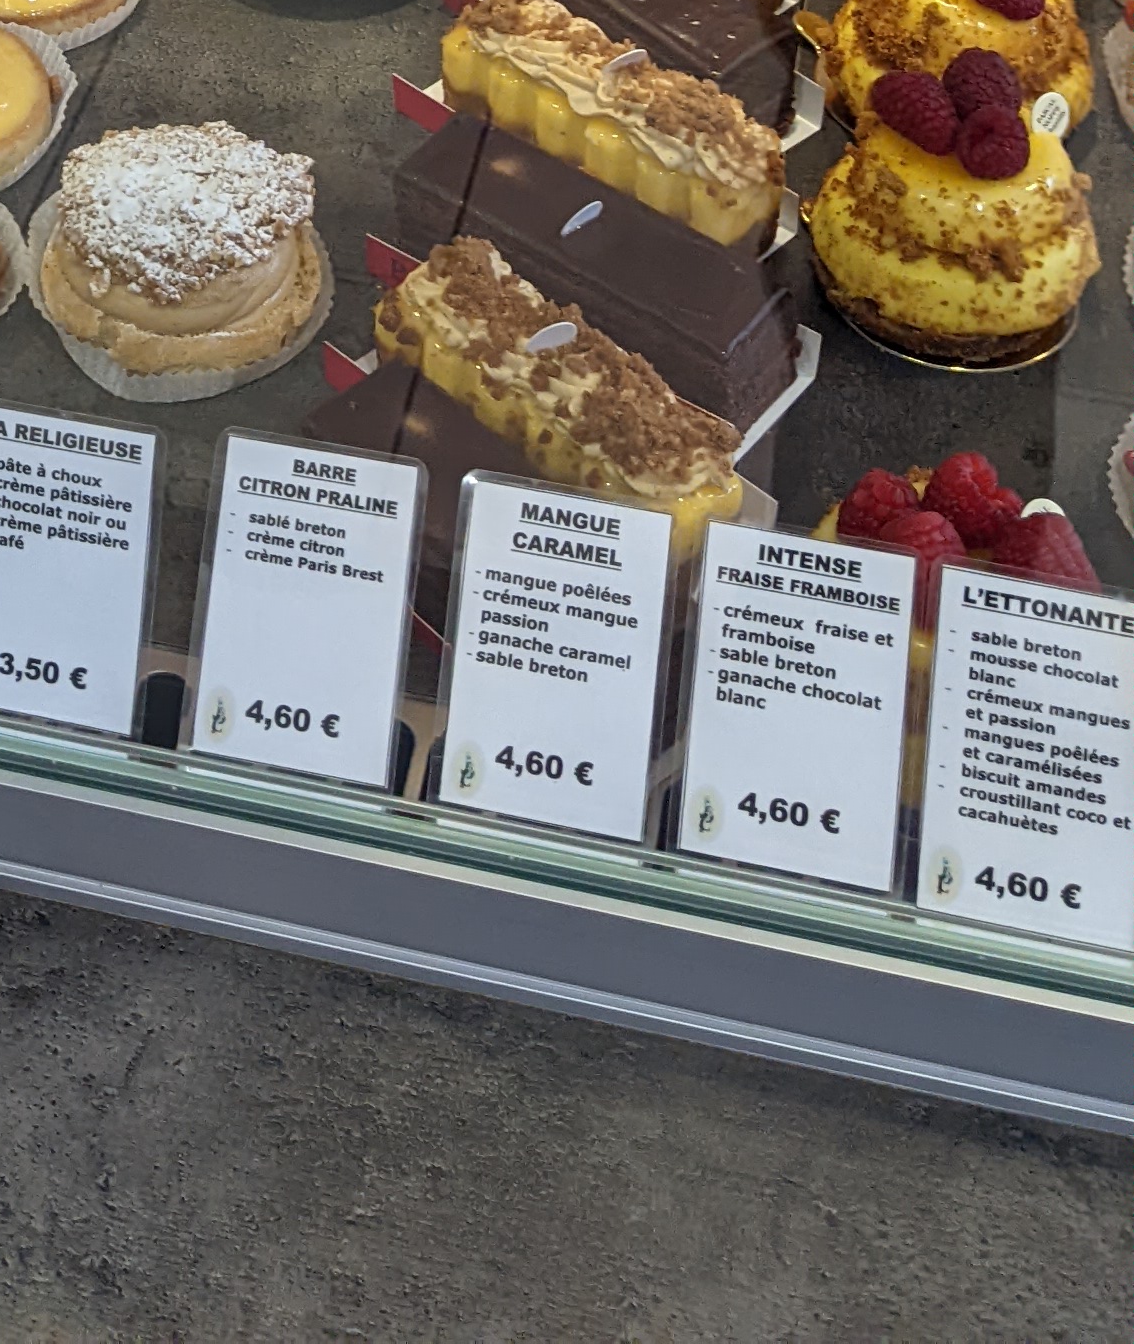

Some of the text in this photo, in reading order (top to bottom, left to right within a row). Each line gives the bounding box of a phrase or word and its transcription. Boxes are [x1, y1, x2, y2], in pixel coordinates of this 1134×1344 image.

[14, 423, 143, 461] RELIGIEUSE
[292, 458, 357, 483] BARRE
[238, 475, 399, 516] CITRON PRALINE
[67, 510, 102, 526] noir
[105, 517, 127, 531] ou
[248, 513, 346, 540] sablé breton
[520, 502, 621, 536] MANGUE
[244, 548, 384, 584] crème Paris Brest
[512, 531, 623, 568] CARAMEL
[758, 543, 863, 579] INTENSE
[484, 568, 632, 607] mangue poêlées
[716, 567, 901, 612] FRAISE FRAMBOISE
[480, 609, 549, 633] passion
[721, 623, 816, 655] framboise
[478, 630, 632, 672] ganache caramel
[68, 666, 88, 690] €
[717, 668, 882, 711] ganache chocolat
[715, 685, 767, 710] blanc
[244, 699, 341, 739] 4,60 €
[494, 745, 595, 787] 4,60 €
[737, 791, 841, 835] 4,60 €
[957, 805, 1059, 836] cacahuètes
[959, 786, 1132, 831] croustillant coco et
[974, 865, 1082, 910] 4,60 €
